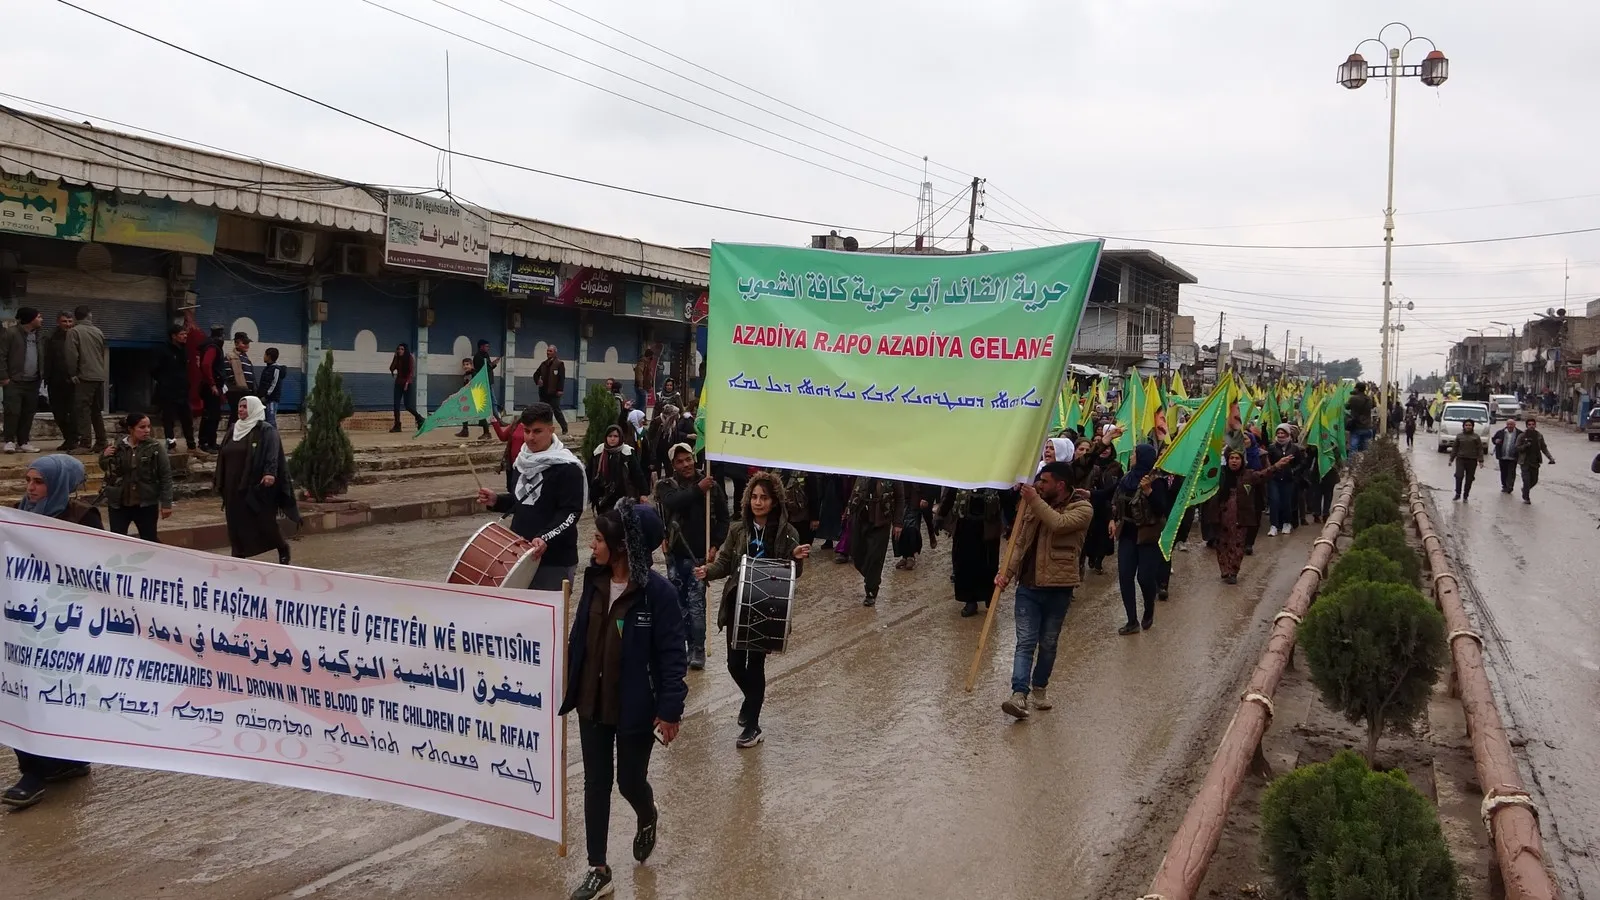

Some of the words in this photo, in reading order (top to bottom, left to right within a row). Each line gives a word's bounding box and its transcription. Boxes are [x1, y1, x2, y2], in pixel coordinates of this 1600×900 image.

[420, 222, 460, 249] للصرافة
[462, 232, 488, 255] سيراج
[581, 280, 612, 294] العطورات
[642, 285, 672, 307] Sima
[738, 270, 803, 300] الشعوب
[806, 272, 849, 302] كافة
[852, 275, 905, 312] حرية
[906, 277, 940, 313] آبو
[944, 275, 1009, 304] القائد
[1012, 272, 1070, 312] حرية
[732, 322, 807, 349] AZADİYA
[812, 331, 873, 355] R.APO
[876, 330, 964, 358] AZADİYA
[720, 420, 769, 440] H.P.C
[4, 598, 48, 631] رفعت
[6, 554, 50, 583] XWÎNA
[56, 564, 111, 594] ZAROKÊN
[116, 574, 134, 599] TIL
[140, 578, 188, 611] RIFETÊ,
[193, 581, 208, 610] DÊ
[214, 587, 268, 622] FAŞÎZMA
[276, 599, 346, 634] TIRKIYEYÊ
[352, 606, 360, 636] Û
[366, 614, 427, 648] ÇETEYÊN
[434, 622, 456, 653] WÊ
[462, 631, 540, 666] BIFETISÎNE
[55, 602, 82, 634] تل
[89, 606, 141, 638] أطفال
[148, 617, 182, 644] دماء
[189, 624, 206, 659] في
[210, 628, 293, 667] مرتزقتها
[302, 654, 312, 672] و
[318, 646, 386, 681] التركية
[392, 658, 464, 694] الفاشية
[473, 670, 542, 709] ستغرق
[4, 642, 32, 667] TURKISH
[34, 648, 84, 672] FASCISM
[86, 654, 112, 676] AND
[114, 657, 134, 678] ITS
[136, 660, 212, 688] MERCENARIES
[216, 671, 244, 694] WILL
[246, 676, 284, 700] DROWN
[286, 684, 298, 703] IN
[300, 687, 320, 708] THE
[324, 690, 358, 714] BLOOD
[362, 697, 374, 716] OF
[379, 700, 399, 722] THE
[402, 705, 454, 734] CHILDREN
[458, 716, 472, 736] OF
[476, 719, 496, 742] TAL
[500, 724, 540, 752] RIFAAT
[189, 726, 345, 765] 2003
